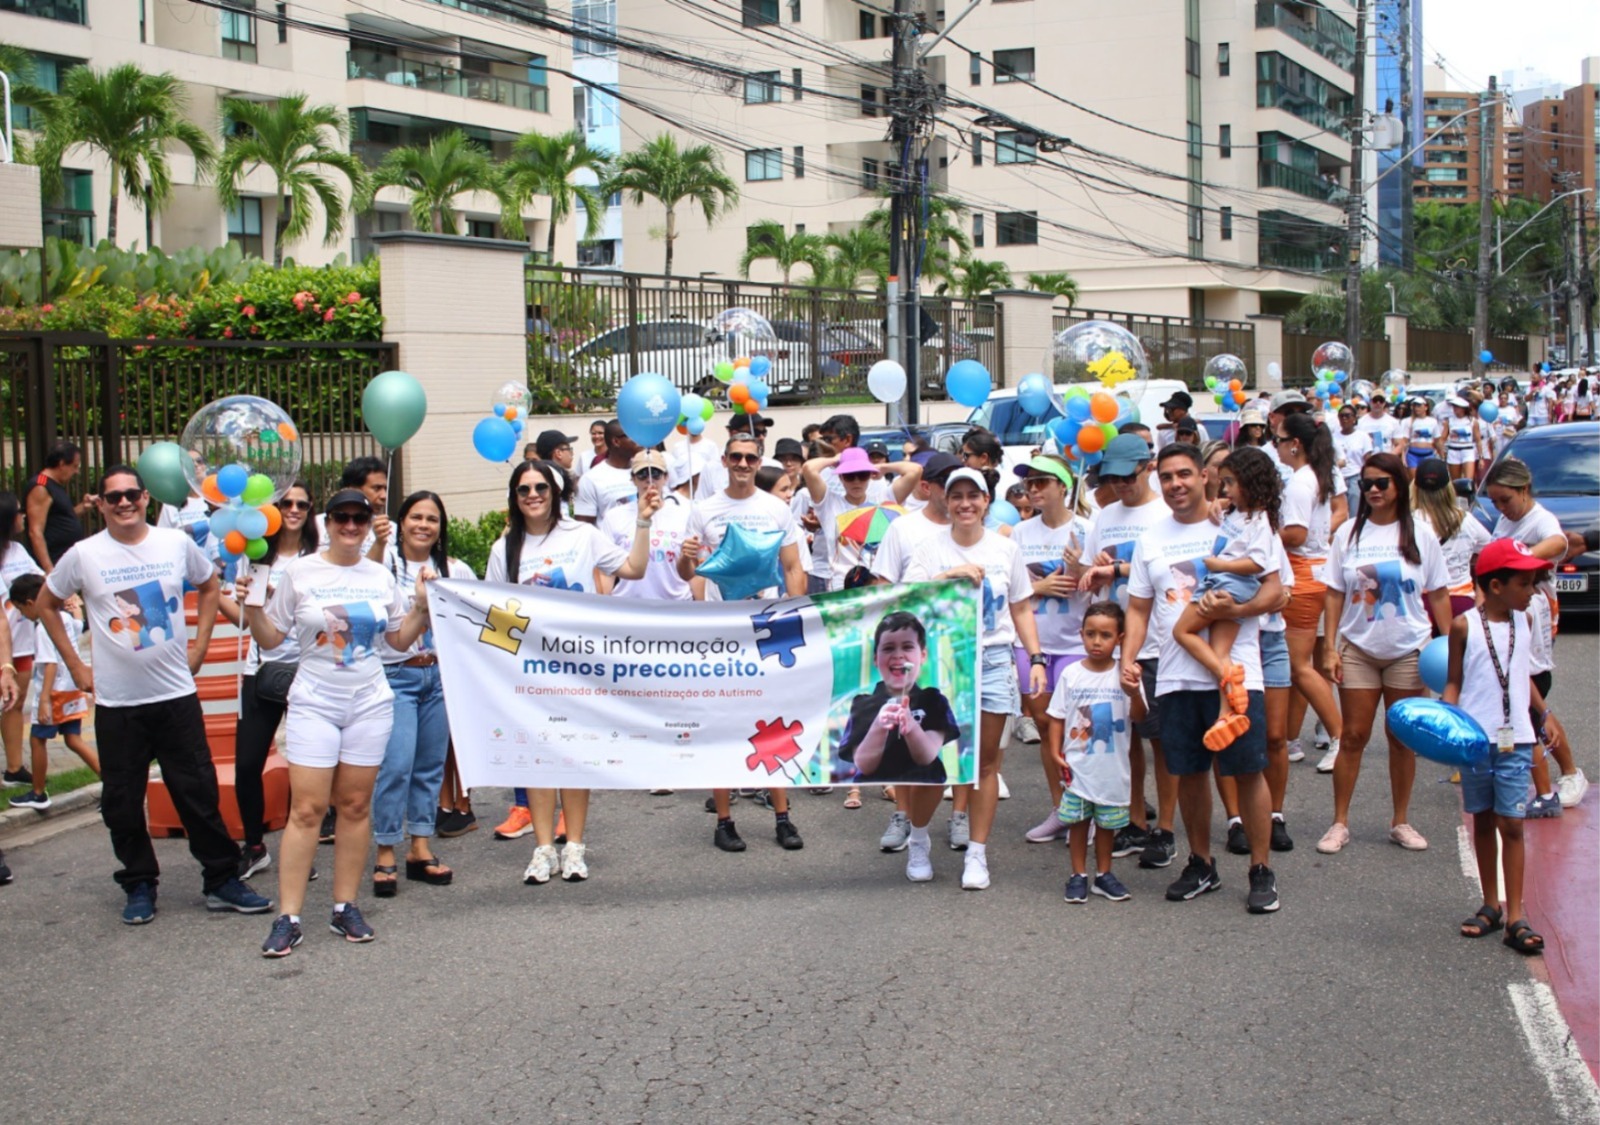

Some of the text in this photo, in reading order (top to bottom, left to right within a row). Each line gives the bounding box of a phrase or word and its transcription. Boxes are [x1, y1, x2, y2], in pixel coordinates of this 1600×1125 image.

[104, 569, 172, 584] DOS MEUS OLHOS
[108, 566, 139, 576] MUNDO
[541, 635, 746, 660] Mais informação,
[523, 657, 765, 683] menos preconceito.
[515, 686, 763, 700] III Caminhada de conscientização do Autismo
